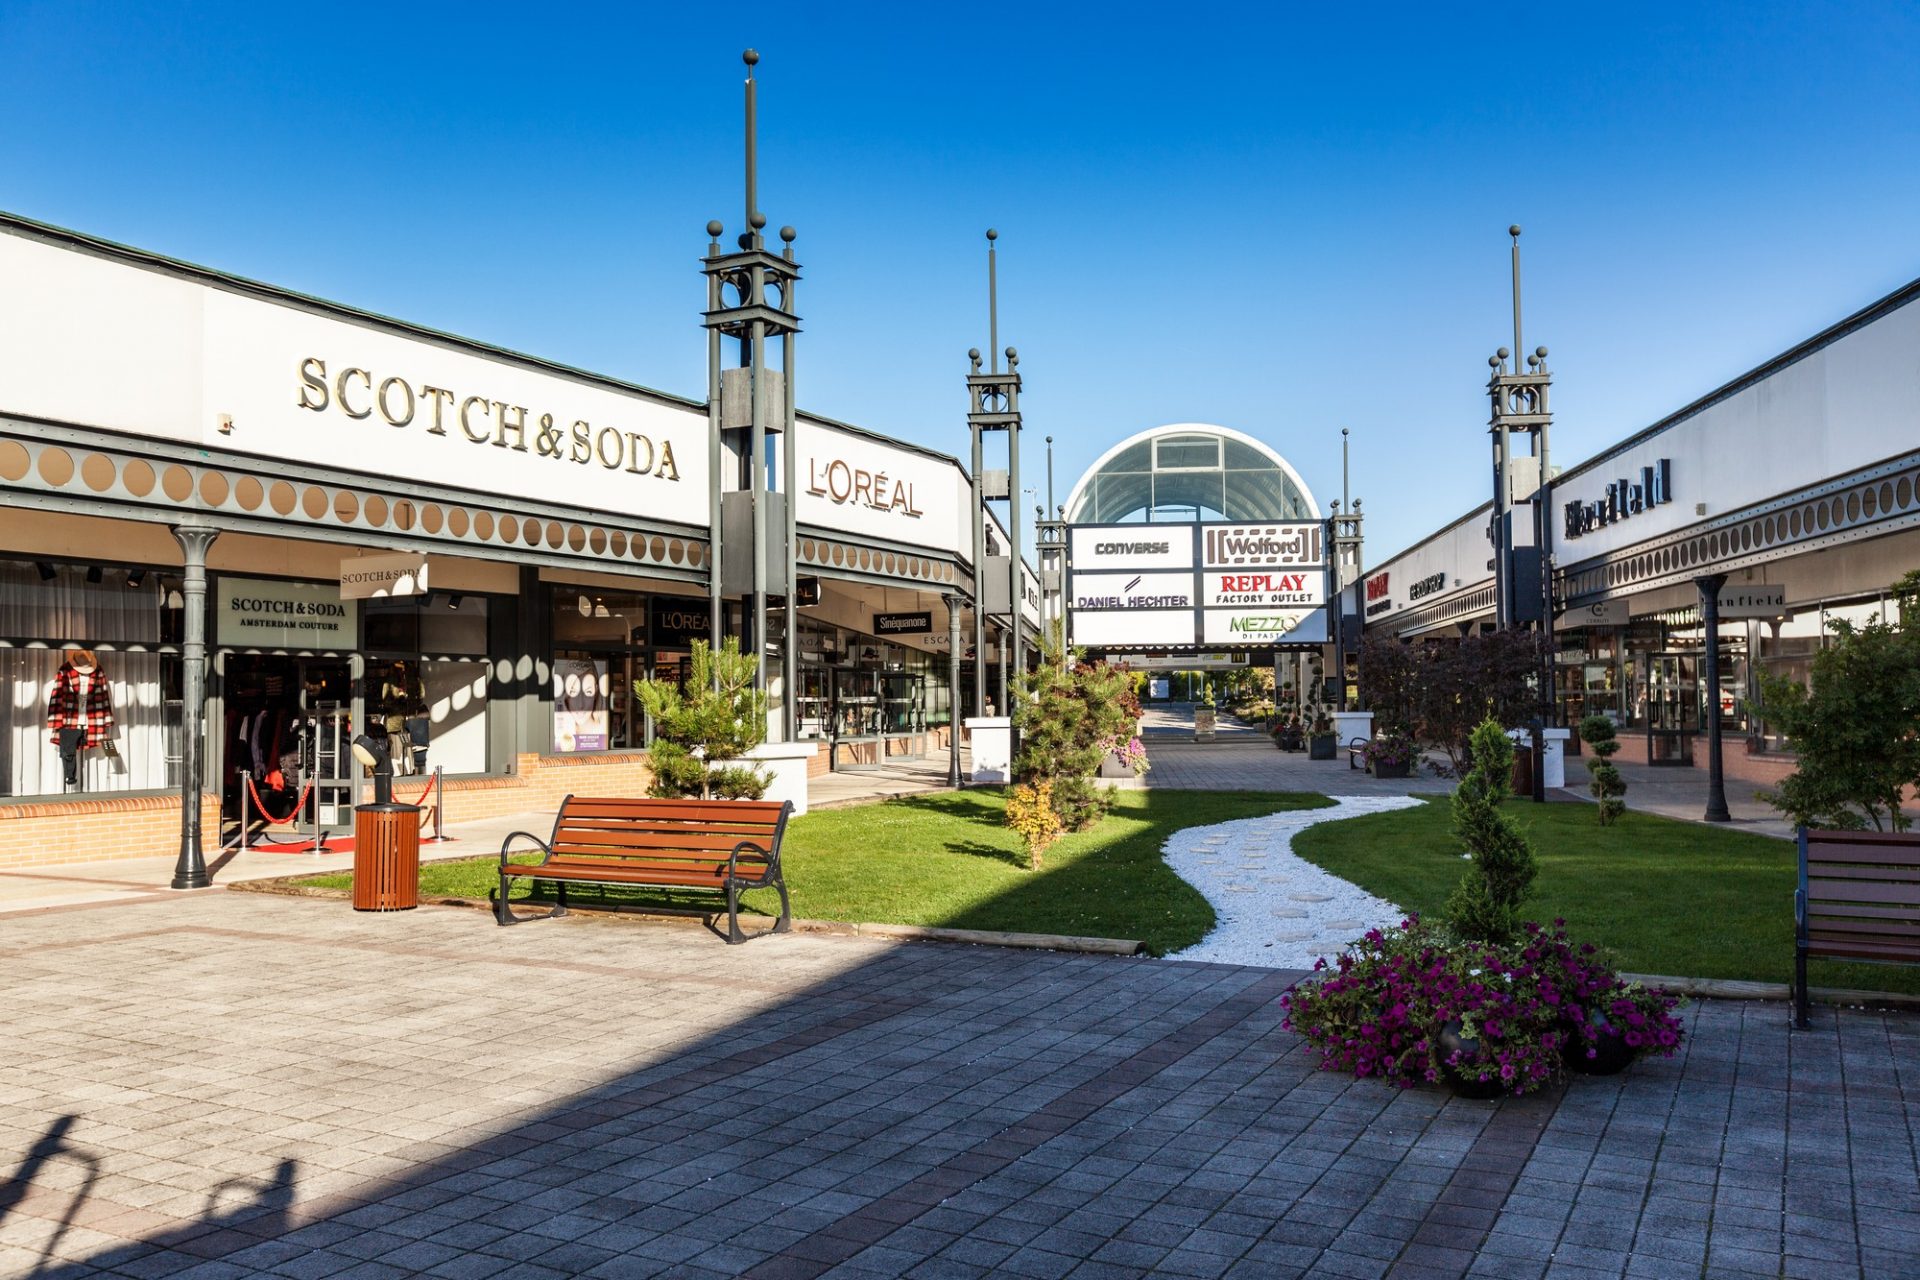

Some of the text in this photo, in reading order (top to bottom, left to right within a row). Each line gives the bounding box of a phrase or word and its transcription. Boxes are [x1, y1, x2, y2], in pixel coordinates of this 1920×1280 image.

[297, 357, 680, 481] SCOTCH&SODA
[810, 458, 923, 517] L'ORÉAL
[1095, 542, 1169, 555] CONVERSE
[1226, 537, 1300, 555] Wolford
[1220, 575, 1307, 592] REPLAY
[1078, 595, 1188, 608] DANIEL HECHTER
[1216, 594, 1313, 603] FACTORY OUTLET
[231, 598, 346, 617] SCOTCH&SODA
[240, 618, 339, 631] AMSTERDAM COUTURE
[662, 612, 711, 630] L'ORÉA
[880, 616, 927, 631] Sinéquanone
[1230, 614, 1300, 632] MEZZO
[924, 636, 965, 645] ESCAA
